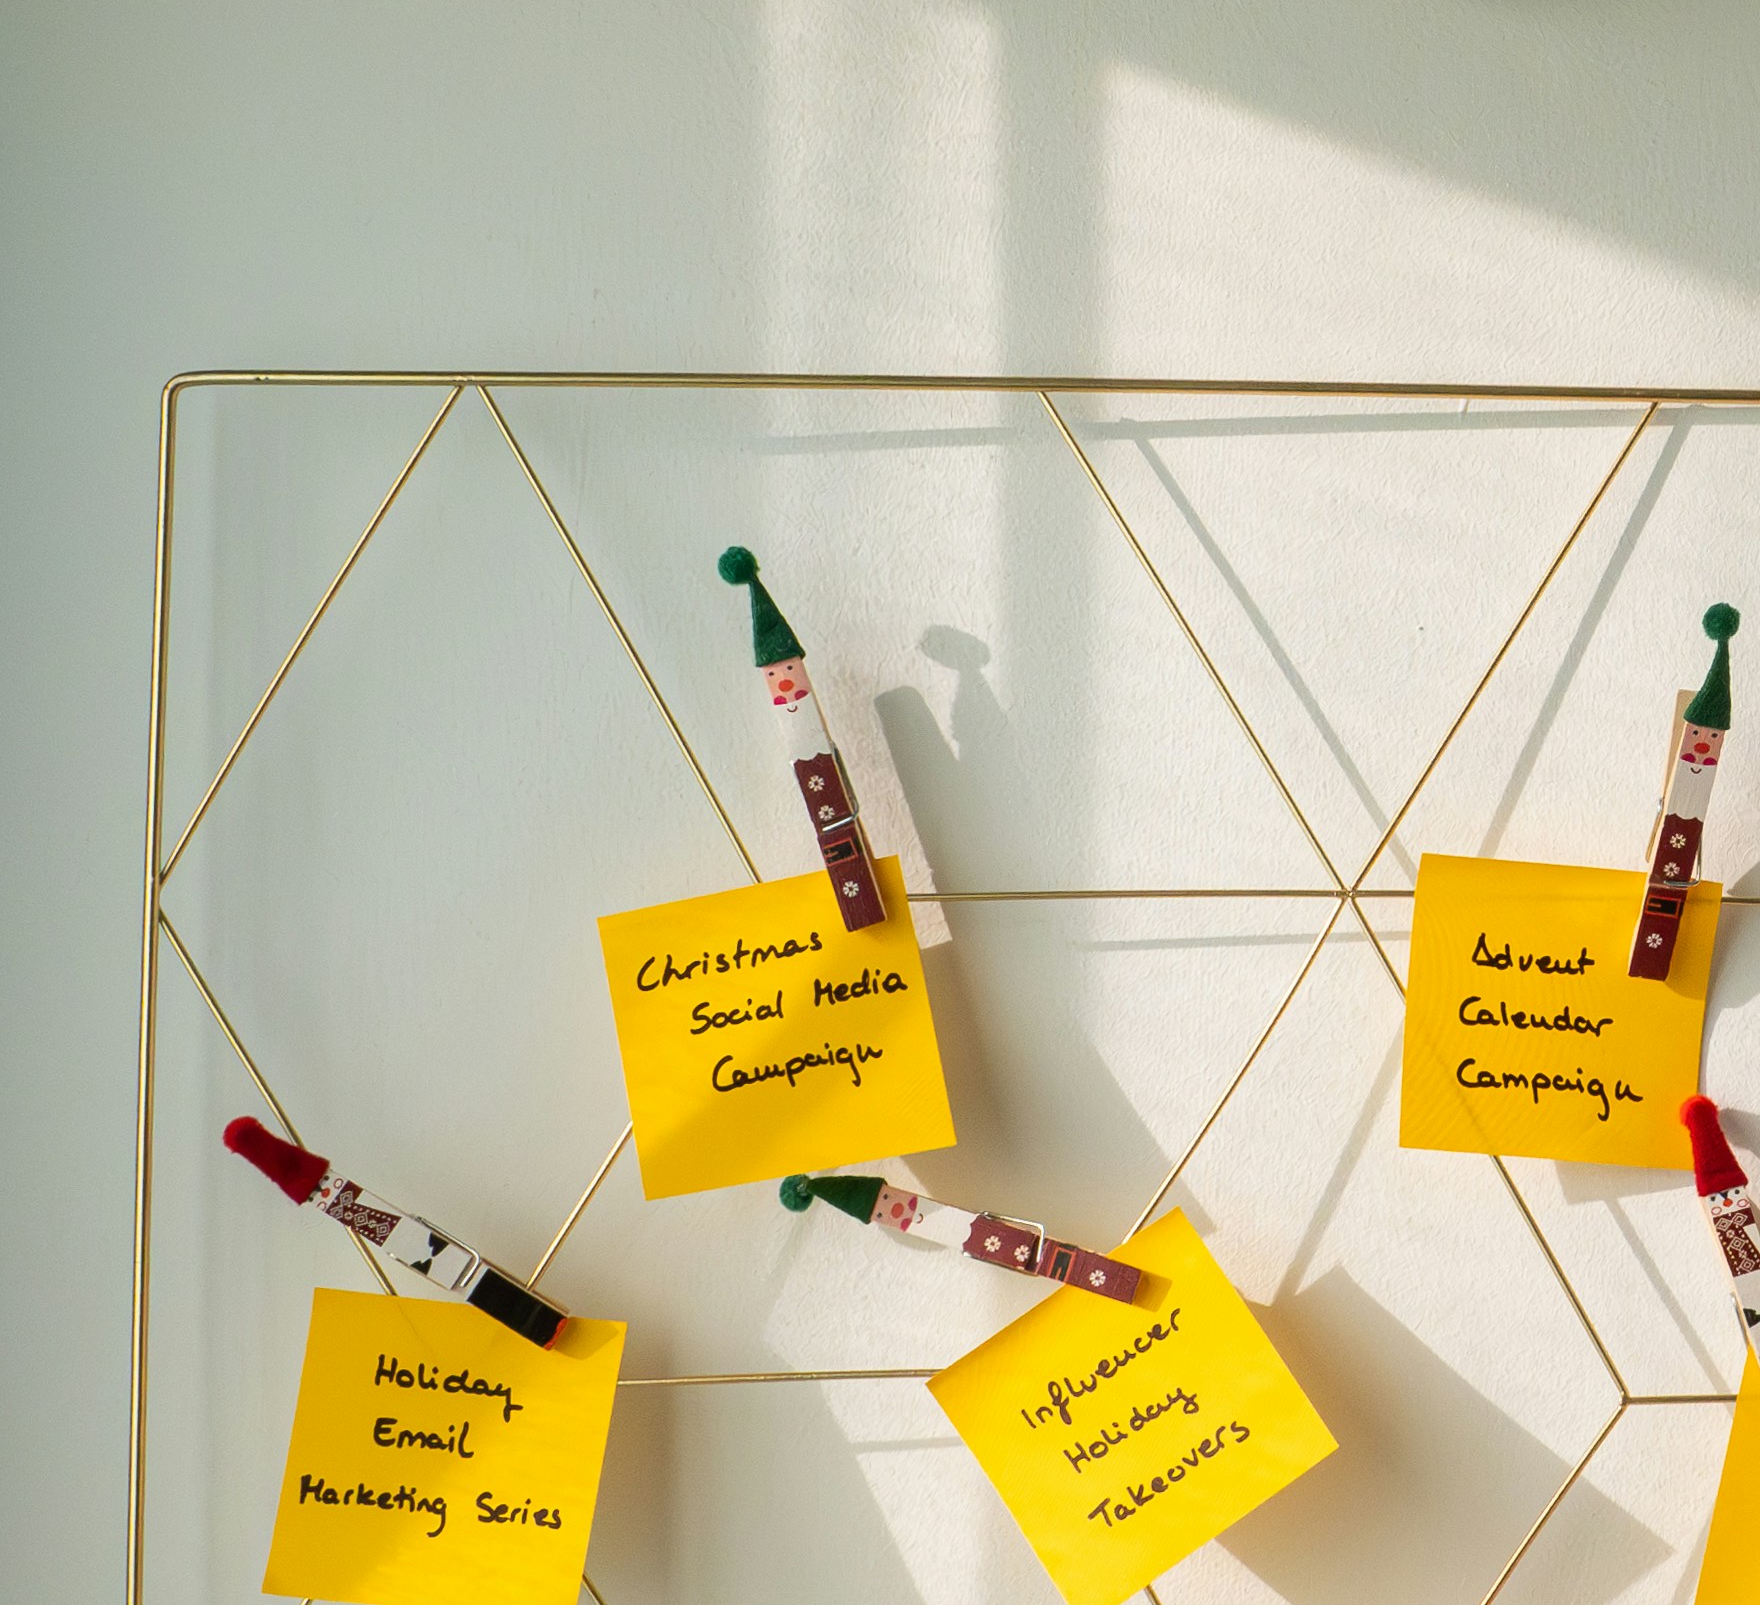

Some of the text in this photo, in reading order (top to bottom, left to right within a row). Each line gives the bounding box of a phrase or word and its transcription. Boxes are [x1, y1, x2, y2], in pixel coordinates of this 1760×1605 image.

[637, 932, 823, 991] Christmas
[1472, 933, 1595, 975] Advent
[690, 969, 908, 1035] Social Media
[1459, 996, 1613, 1037] Calendar
[712, 1043, 882, 1092] Campaign
[1457, 1058, 1643, 1121] Campaign
[375, 1354, 523, 1423] Holiday
[1021, 1308, 1182, 1425] Influencer
[374, 1418, 474, 1458] Email
[1063, 1387, 1199, 1473] Holiday
[1088, 1420, 1250, 1527] Takeovers
[300, 1474, 561, 1537] Marketing Series
